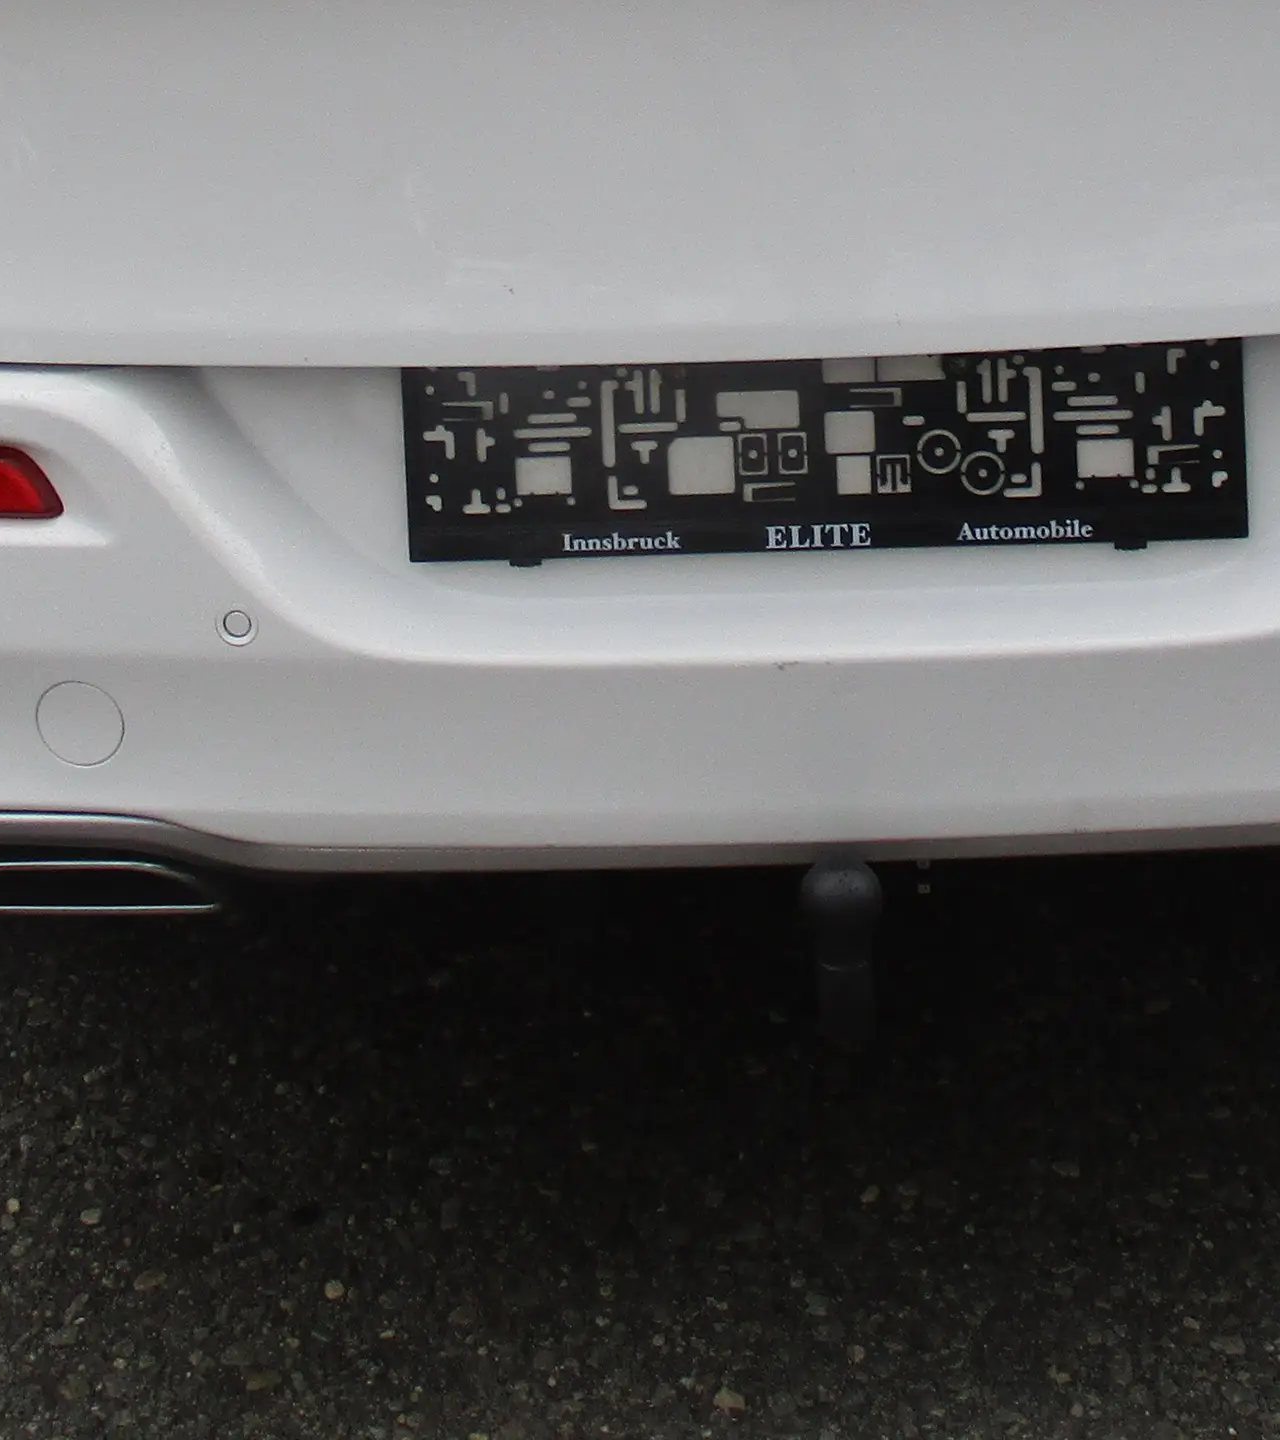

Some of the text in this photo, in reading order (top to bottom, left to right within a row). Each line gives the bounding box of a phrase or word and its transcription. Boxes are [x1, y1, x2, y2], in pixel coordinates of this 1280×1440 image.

[561, 517, 1094, 552] Innsbruck ELITE Automobile
